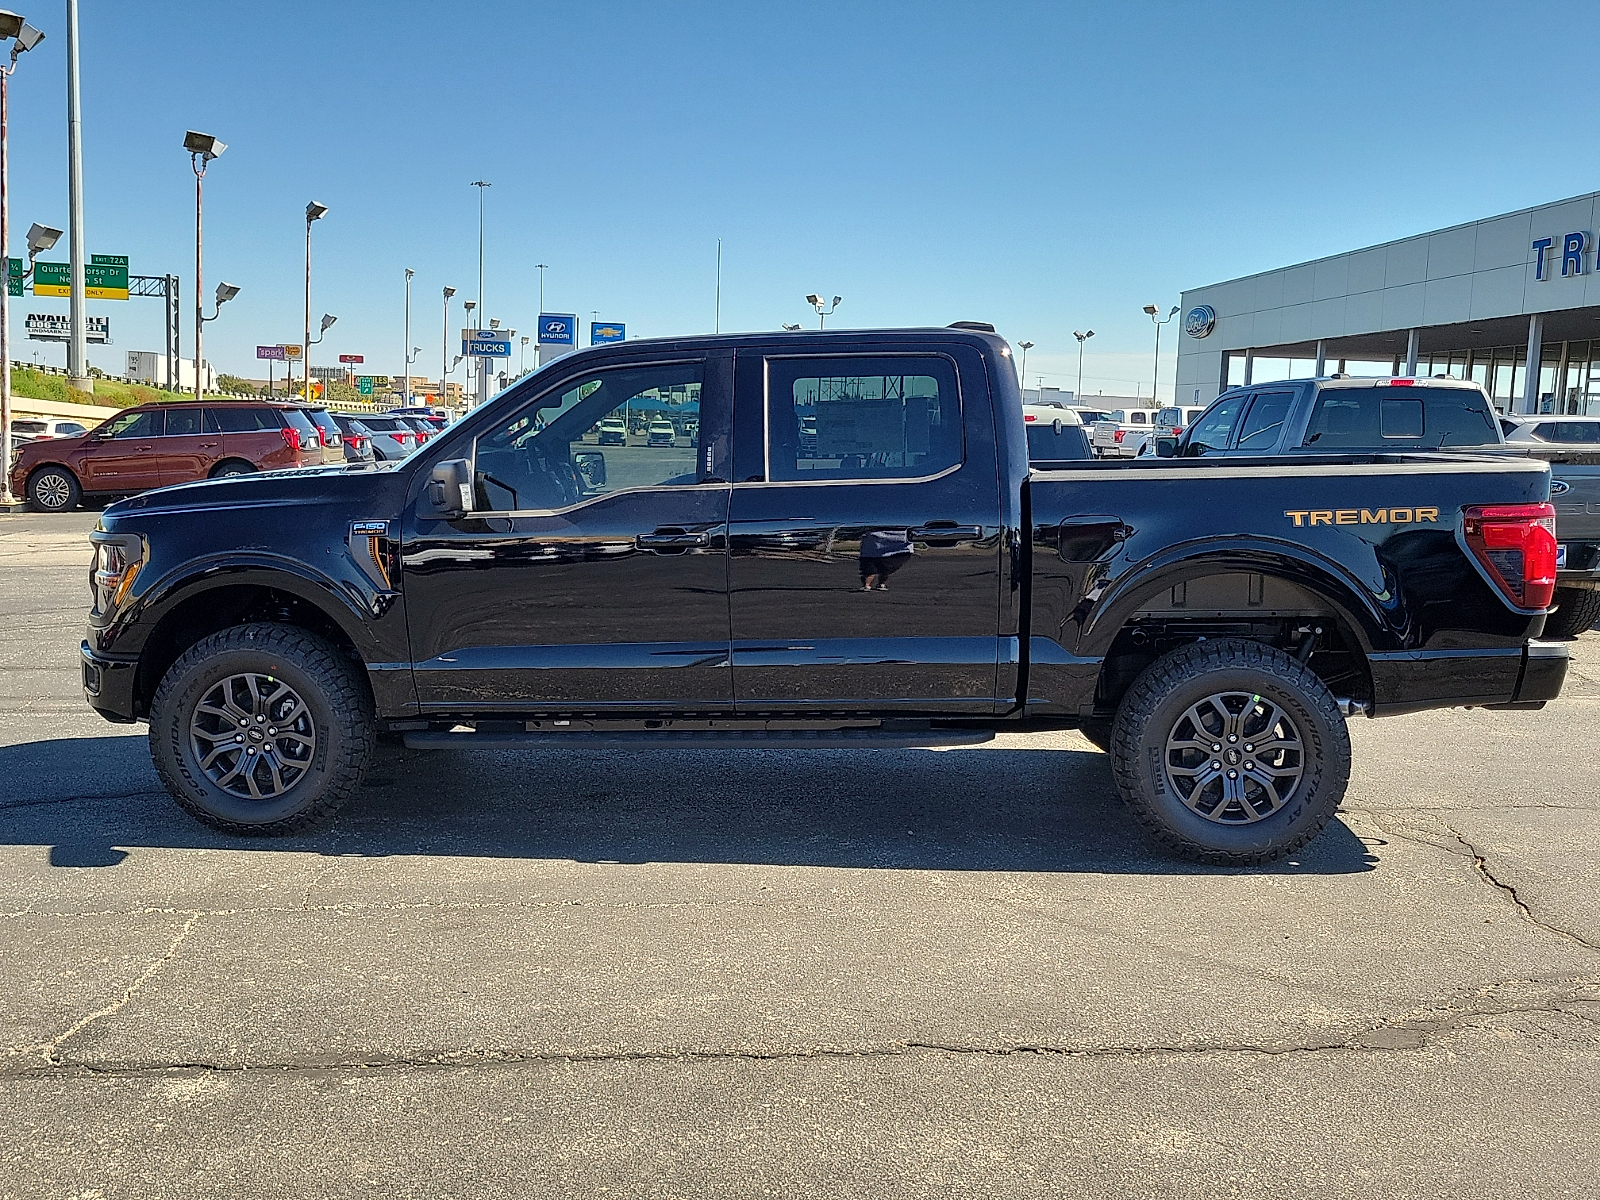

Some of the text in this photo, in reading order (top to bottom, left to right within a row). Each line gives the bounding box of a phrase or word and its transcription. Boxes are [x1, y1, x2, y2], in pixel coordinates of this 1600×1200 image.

[41, 265, 71, 274] Quarte
[86, 268, 106, 276] orse
[93, 277, 103, 285] St
[27, 314, 104, 325] AVAILLE
[260, 348, 283, 358] spark
[469, 343, 505, 353] TRUCKS
[1286, 507, 1440, 527] TREMOR
[354, 522, 386, 530] F-150
[1265, 684, 1324, 762] SCORPION
[170, 715, 209, 798] SCORPION
